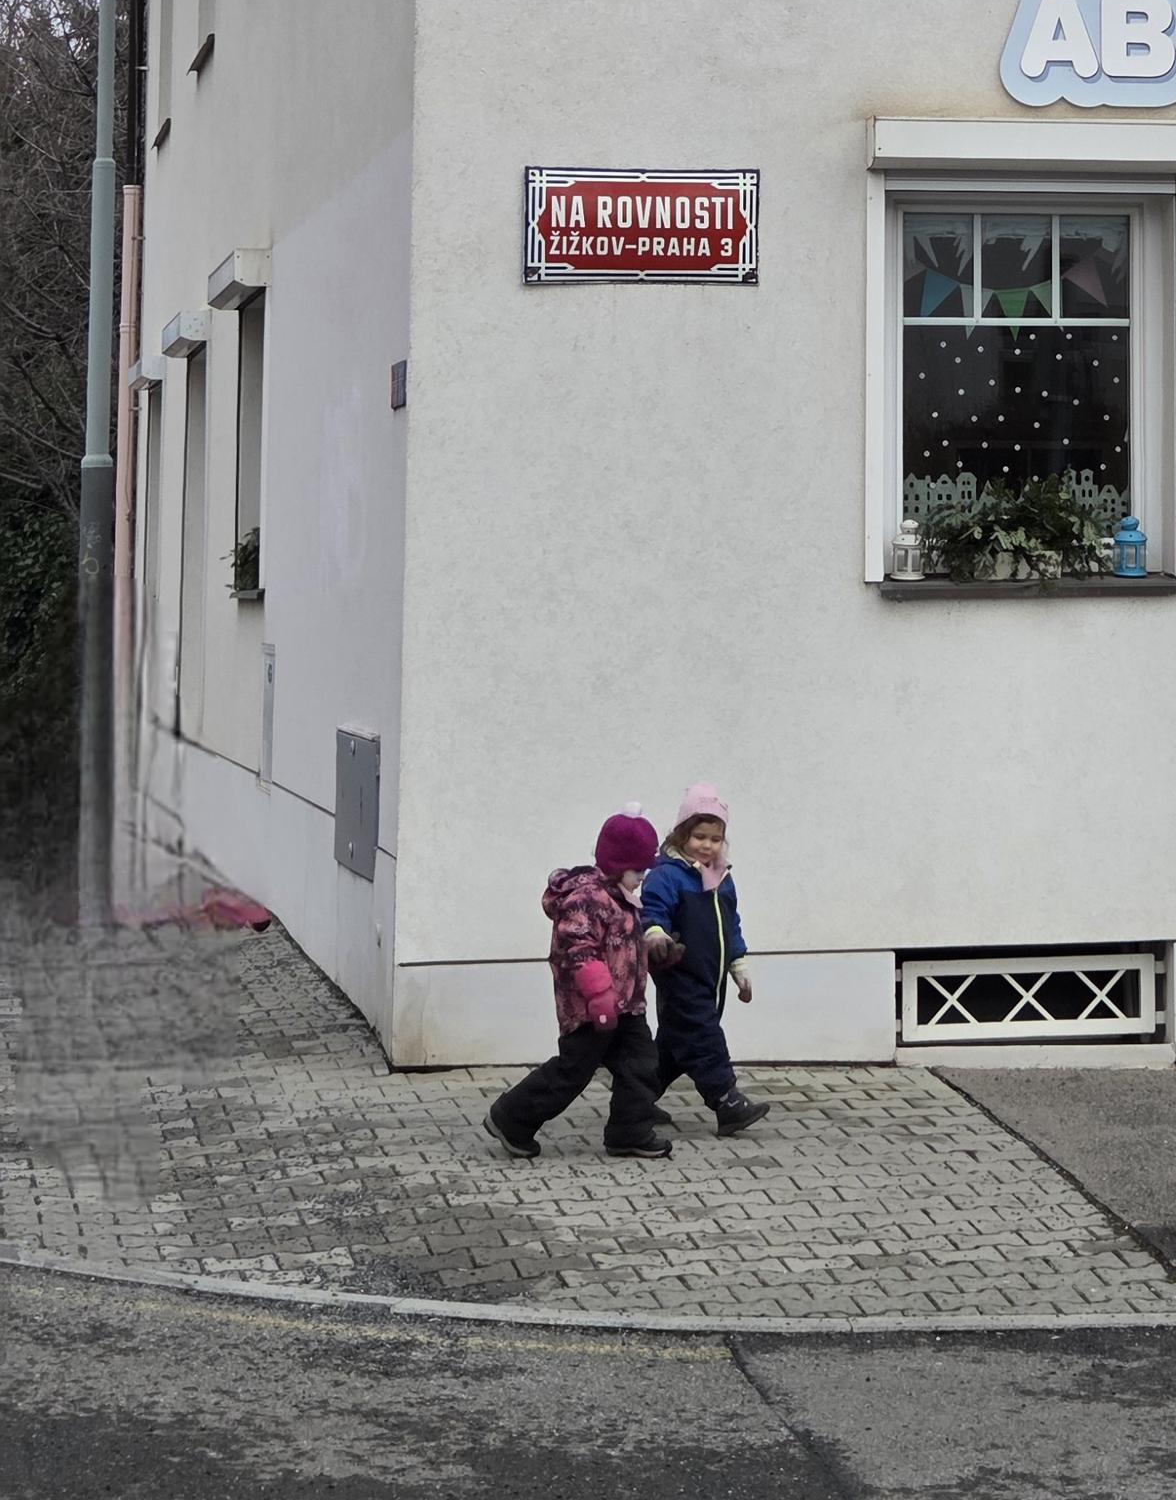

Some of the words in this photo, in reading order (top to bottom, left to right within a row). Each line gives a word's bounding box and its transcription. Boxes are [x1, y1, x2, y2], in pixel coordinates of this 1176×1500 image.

[551, 195, 586, 228] NA
[597, 195, 734, 230] ROVNOSTI
[720, 238, 733, 257] 3
